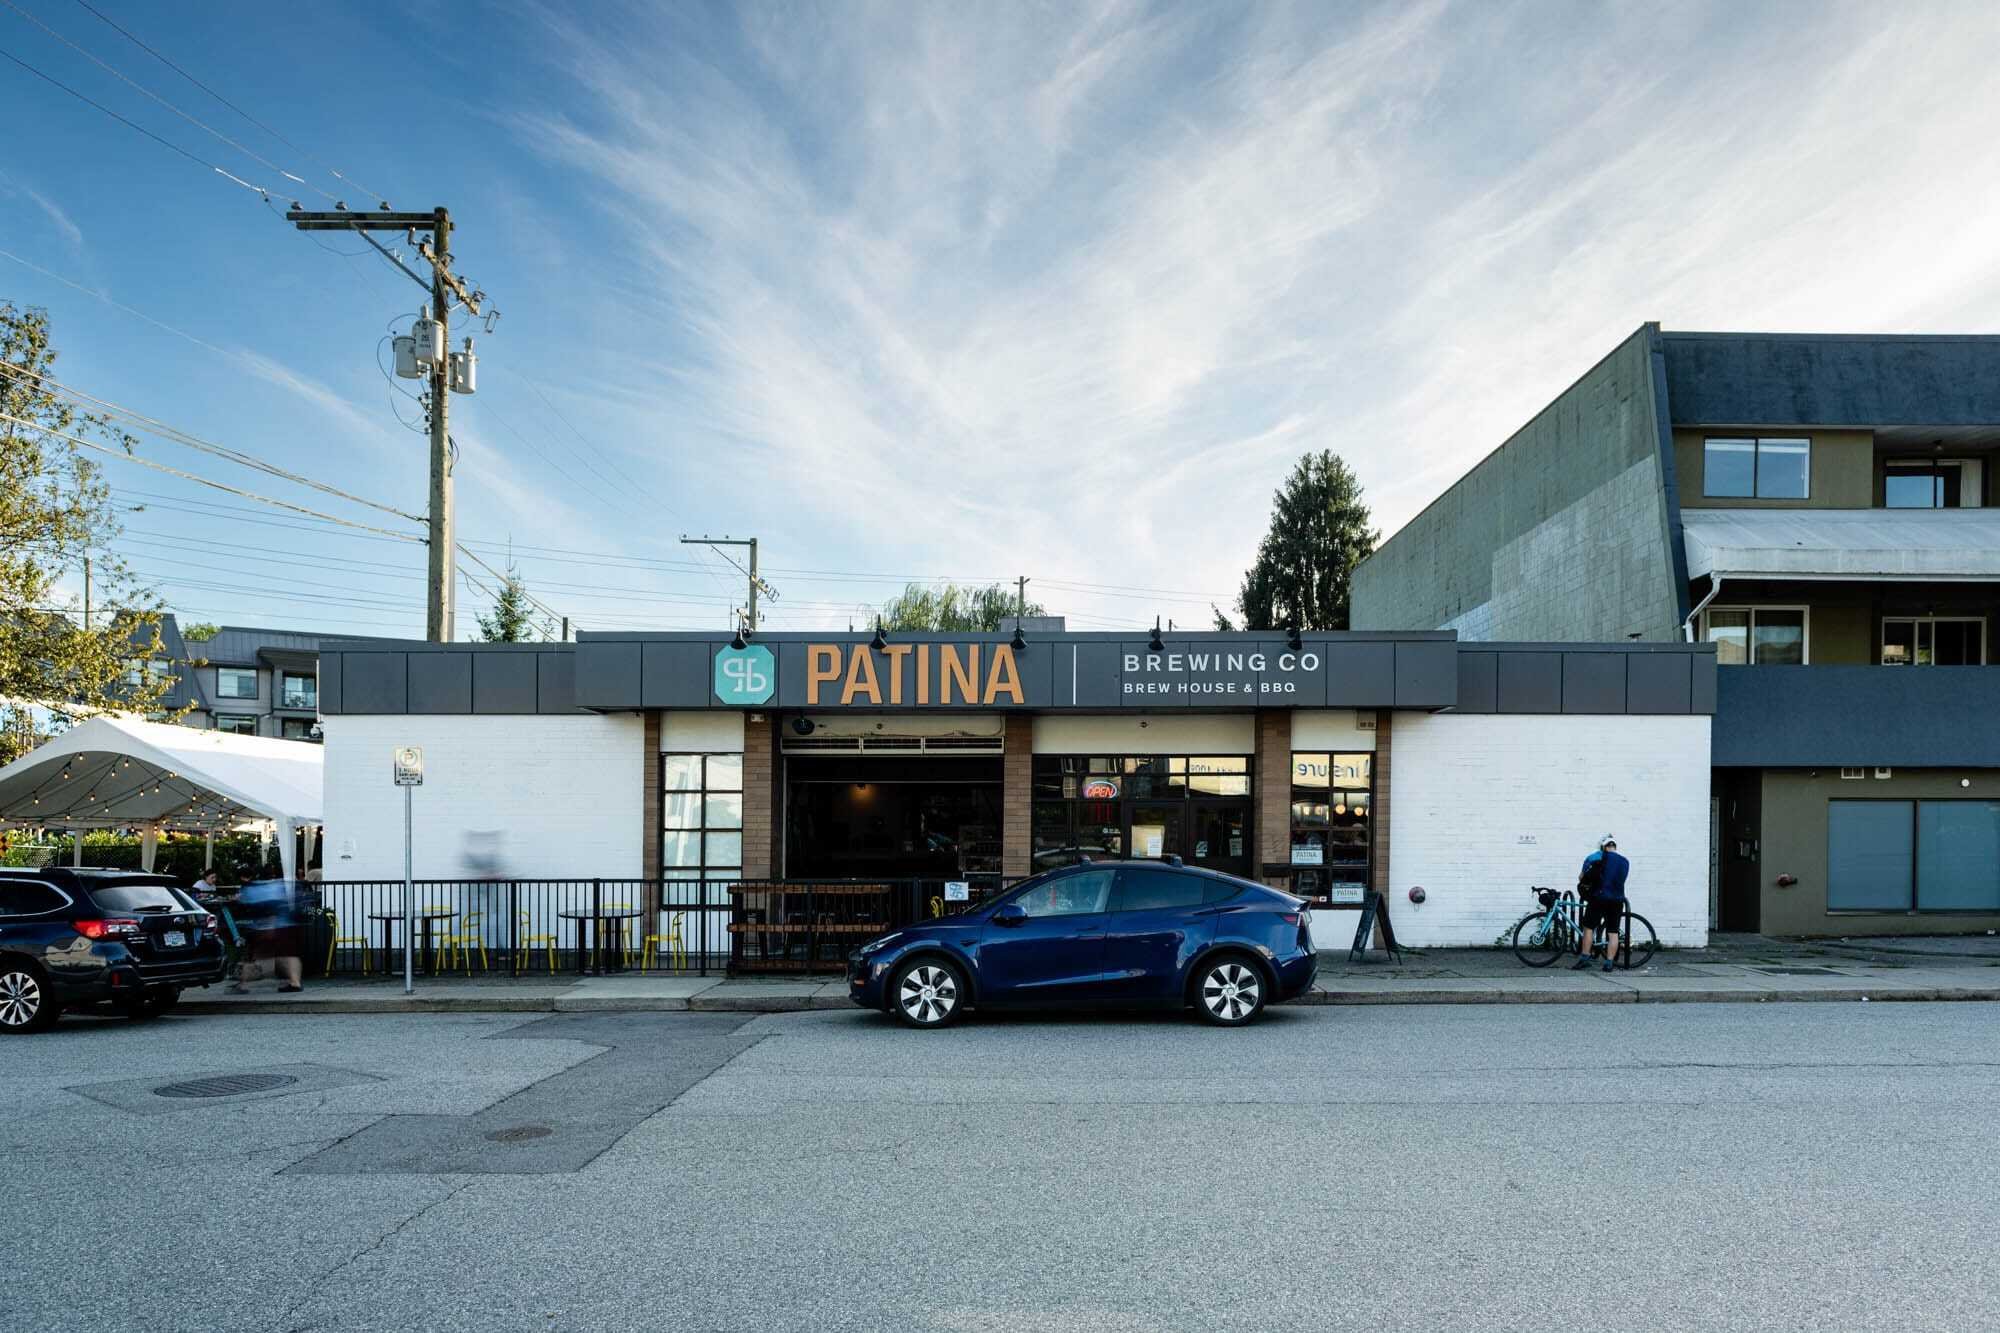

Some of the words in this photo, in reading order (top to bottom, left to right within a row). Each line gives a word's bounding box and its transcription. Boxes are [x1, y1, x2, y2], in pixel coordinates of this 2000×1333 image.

[1124, 654, 1266, 672] BREWING
[1278, 653, 1320, 672] CO
[807, 645, 1025, 705] PATINA
[1124, 682, 1171, 693] BREW
[1178, 682, 1236, 693] HOUSE
[1243, 683, 1252, 693] &
[1261, 682, 1296, 693] BBQ
[1088, 786, 1114, 798] OPEN
